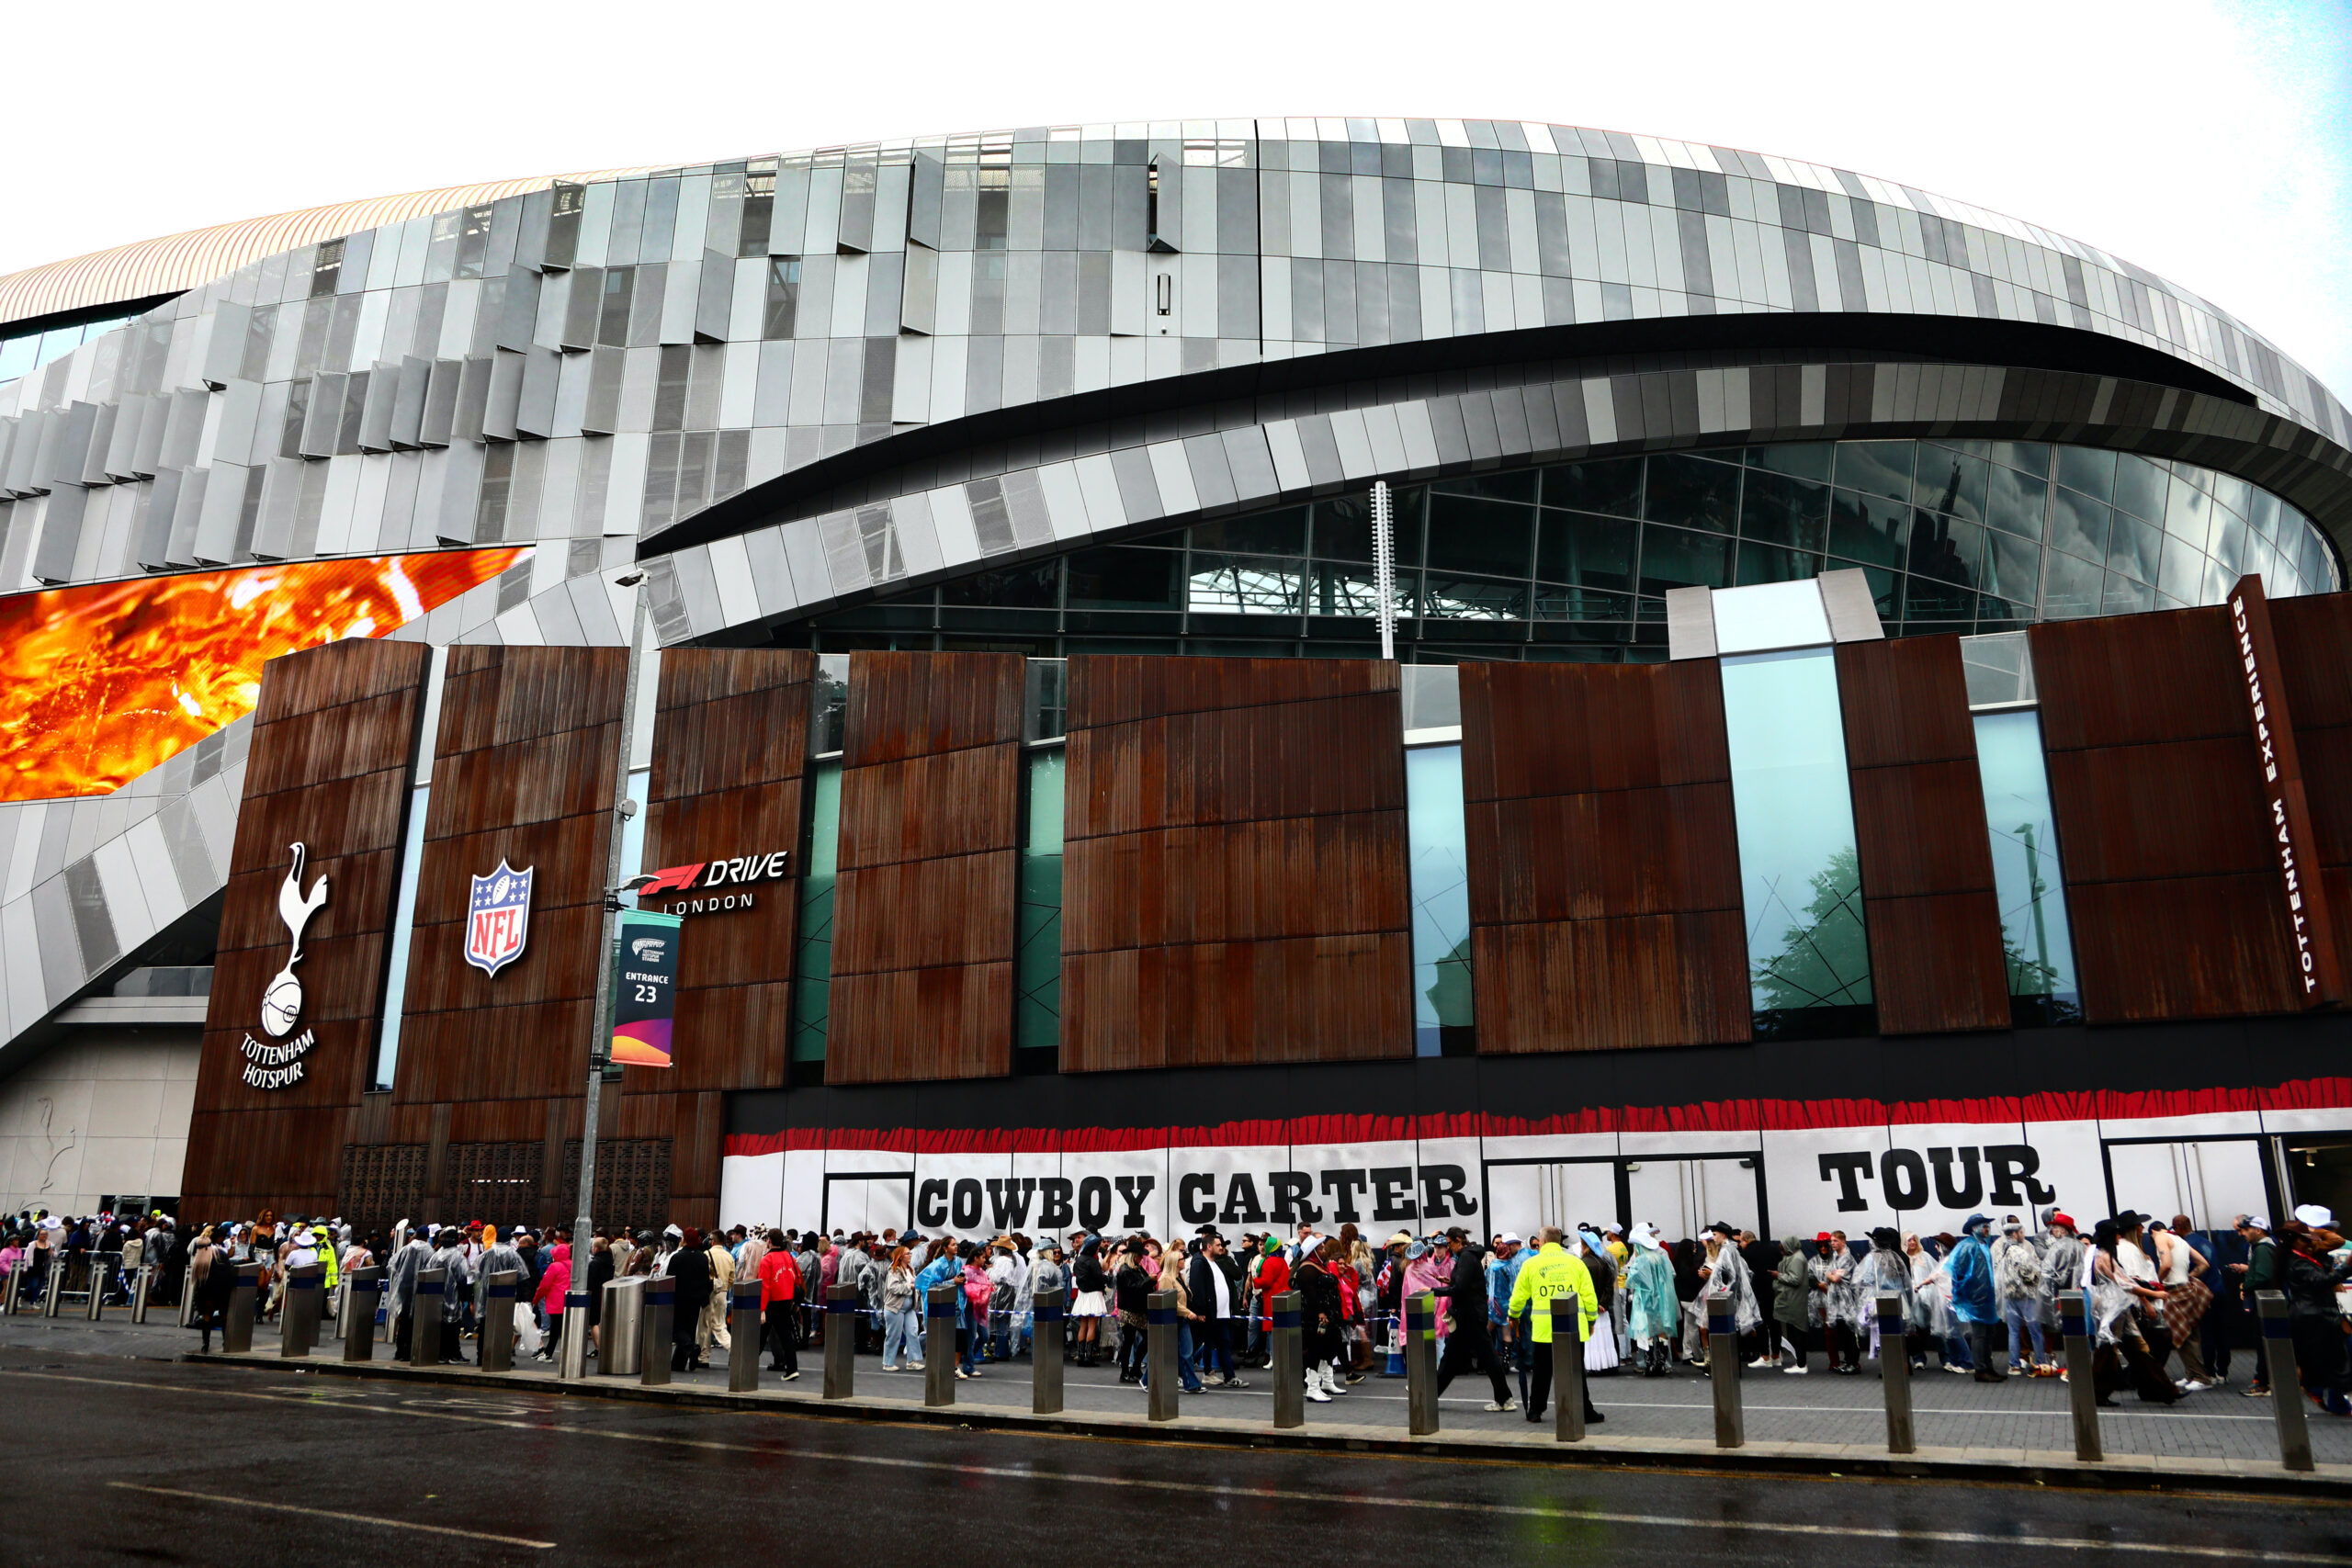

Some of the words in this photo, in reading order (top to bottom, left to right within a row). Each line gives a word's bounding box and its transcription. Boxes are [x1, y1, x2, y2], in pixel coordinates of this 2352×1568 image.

[2233, 595, 2278, 783] EXPERIENCE
[704, 851, 788, 887] DRIVE
[663, 893, 753, 916] LONDON
[2273, 797, 2316, 994] TOTTENHAM
[471, 908, 519, 959] NFL
[626, 972, 669, 985] ENTRANCE
[635, 984, 657, 1003] 23
[240, 1028, 314, 1066] TOTTENHAM
[243, 1061, 304, 1089] HOTSPUR
[918, 1174, 1156, 1229] COWBOY
[1178, 1164, 1479, 1225] CARTER
[1818, 1144, 2056, 1213] TOUR
[1539, 1284, 1575, 1297] 0794
